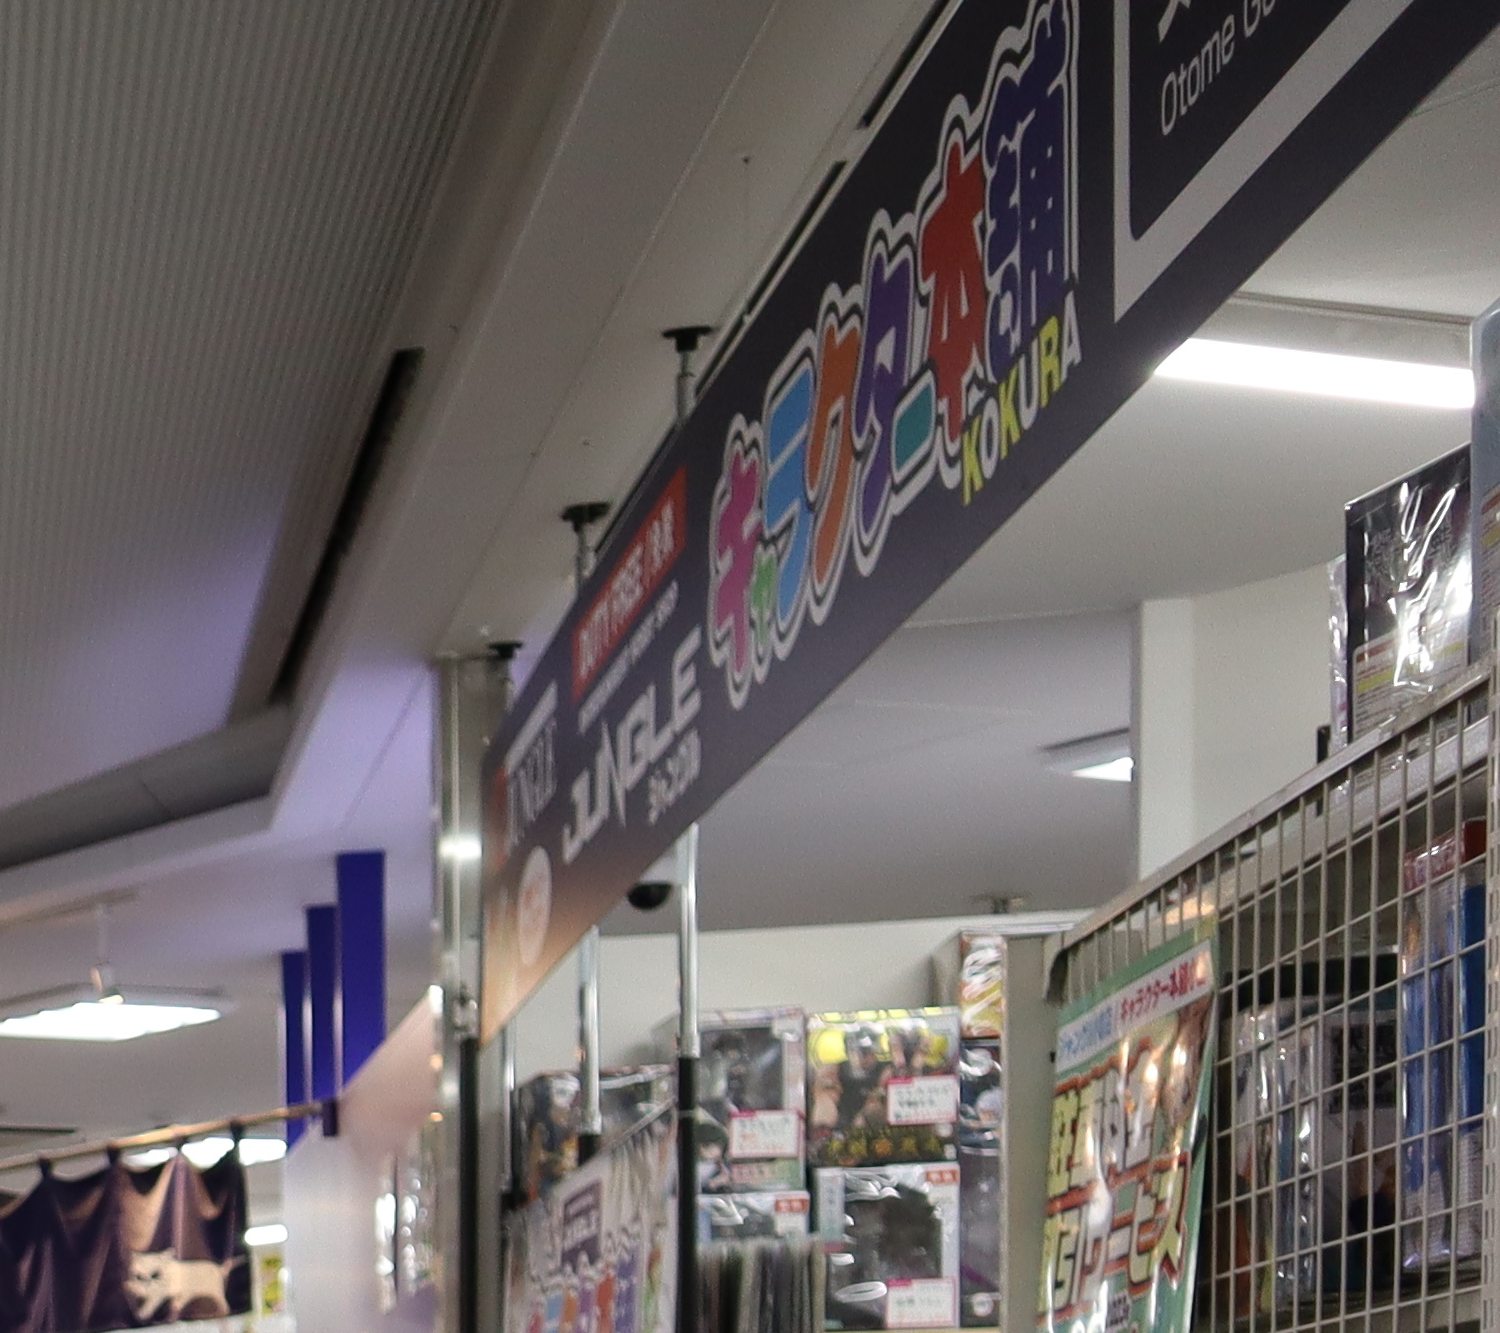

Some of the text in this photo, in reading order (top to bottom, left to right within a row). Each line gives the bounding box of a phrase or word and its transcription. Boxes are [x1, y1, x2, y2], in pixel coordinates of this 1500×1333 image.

[1160, 21, 1236, 136] Otome
[959, 290, 1084, 507] KOKURA
[561, 625, 701, 866] JUNGLE
